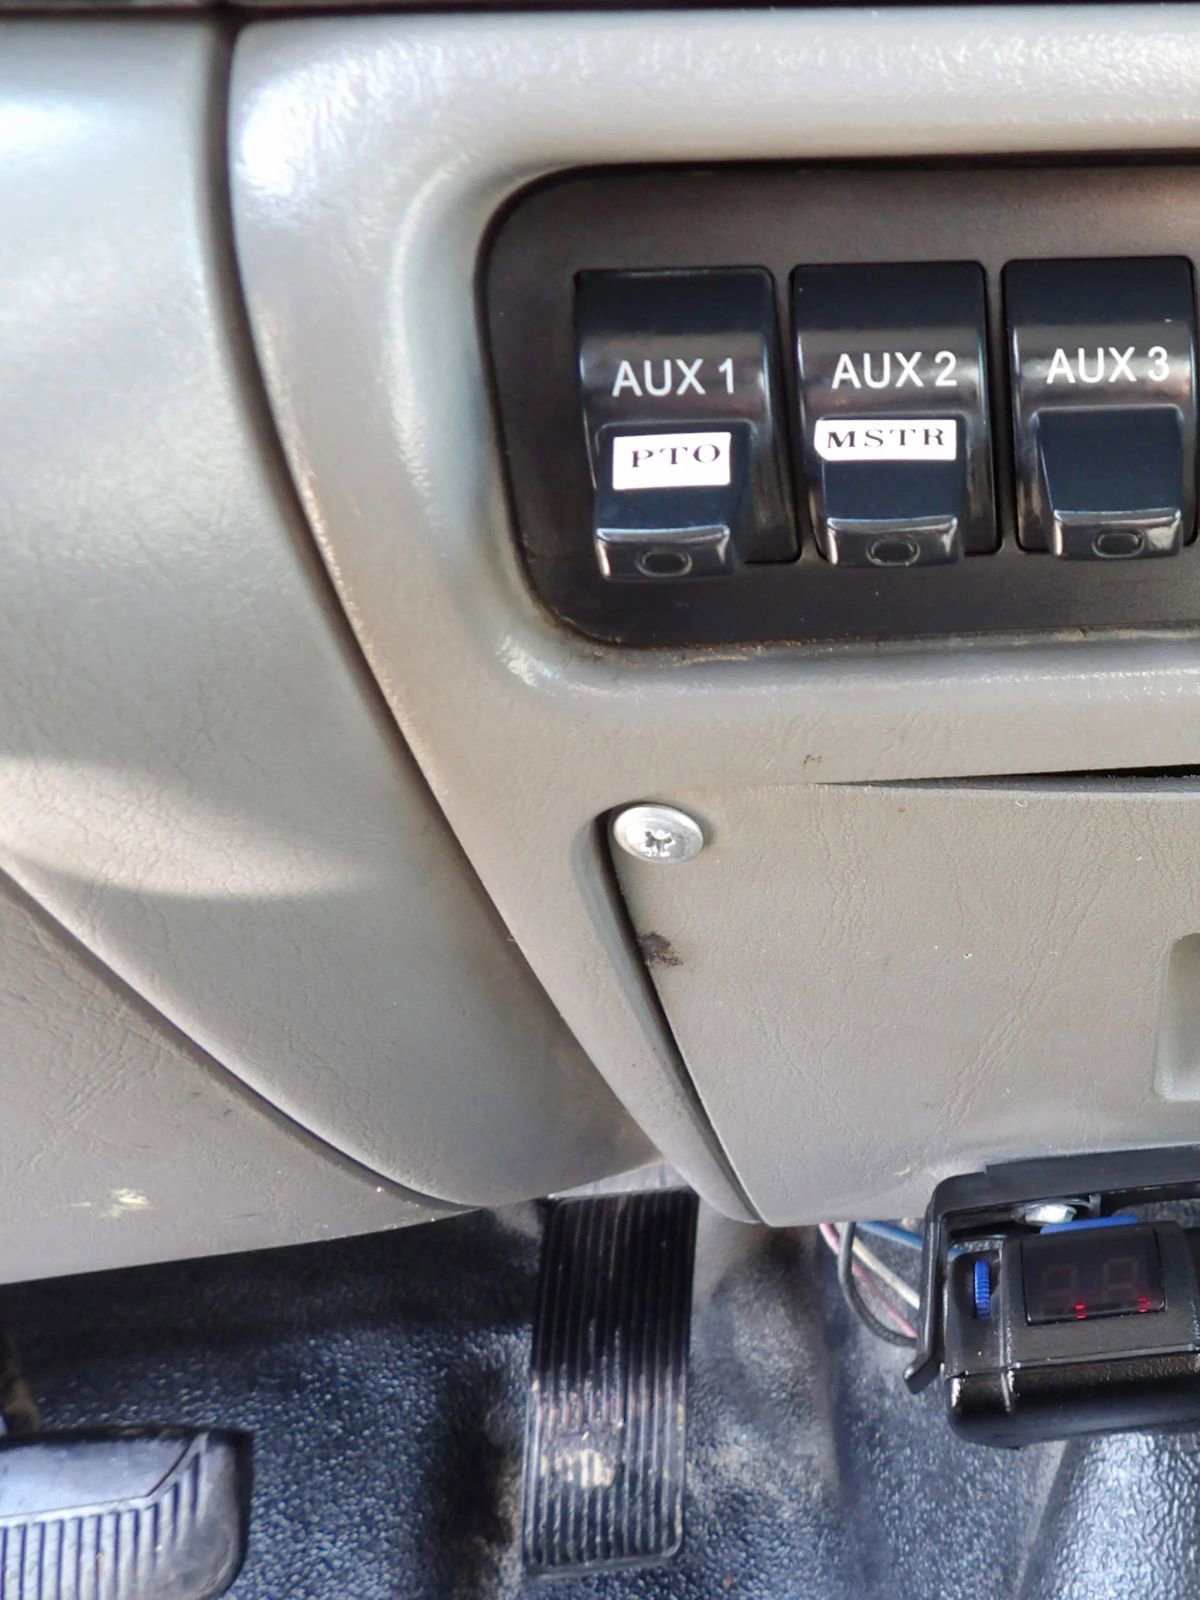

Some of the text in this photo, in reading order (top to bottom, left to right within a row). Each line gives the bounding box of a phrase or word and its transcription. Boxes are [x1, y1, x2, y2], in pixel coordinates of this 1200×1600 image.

[611, 357, 735, 397] AUX 1
[831, 350, 958, 389] AUX 2
[1046, 346, 1170, 384] AUX 3
[630, 443, 721, 469] PTO
[826, 427, 945, 449] MSTR
